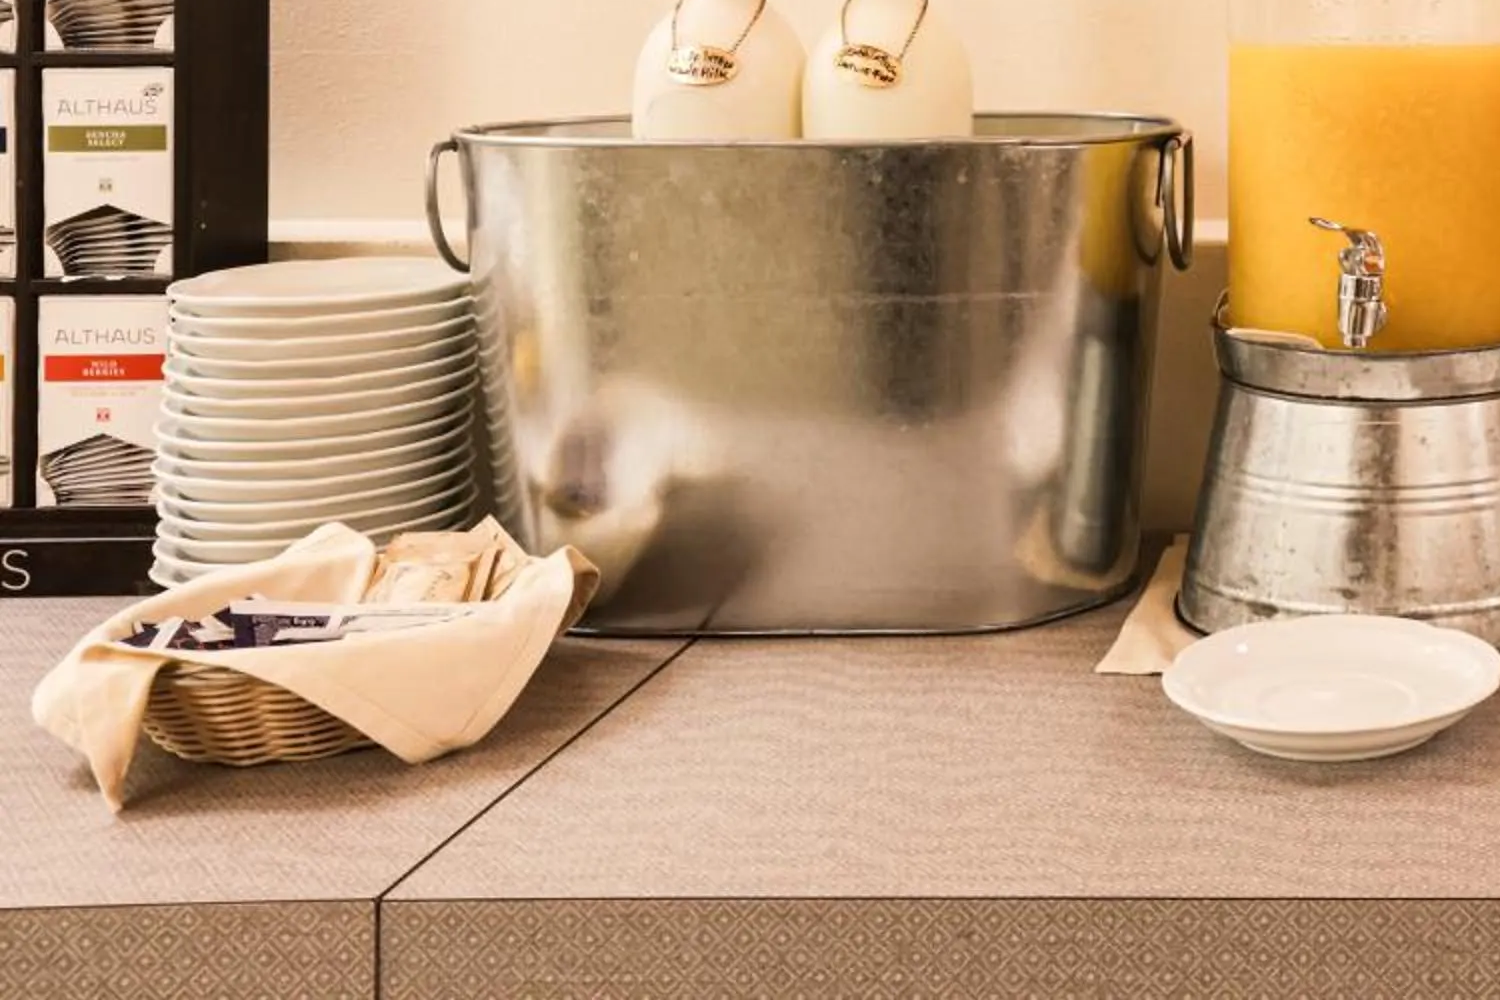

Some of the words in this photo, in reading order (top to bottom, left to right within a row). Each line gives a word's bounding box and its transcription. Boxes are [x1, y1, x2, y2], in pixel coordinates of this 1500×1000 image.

[57, 99, 157, 116] ALTHAUS
[55, 327, 156, 345] ALTHAUS
[1, 549, 30, 590] S
